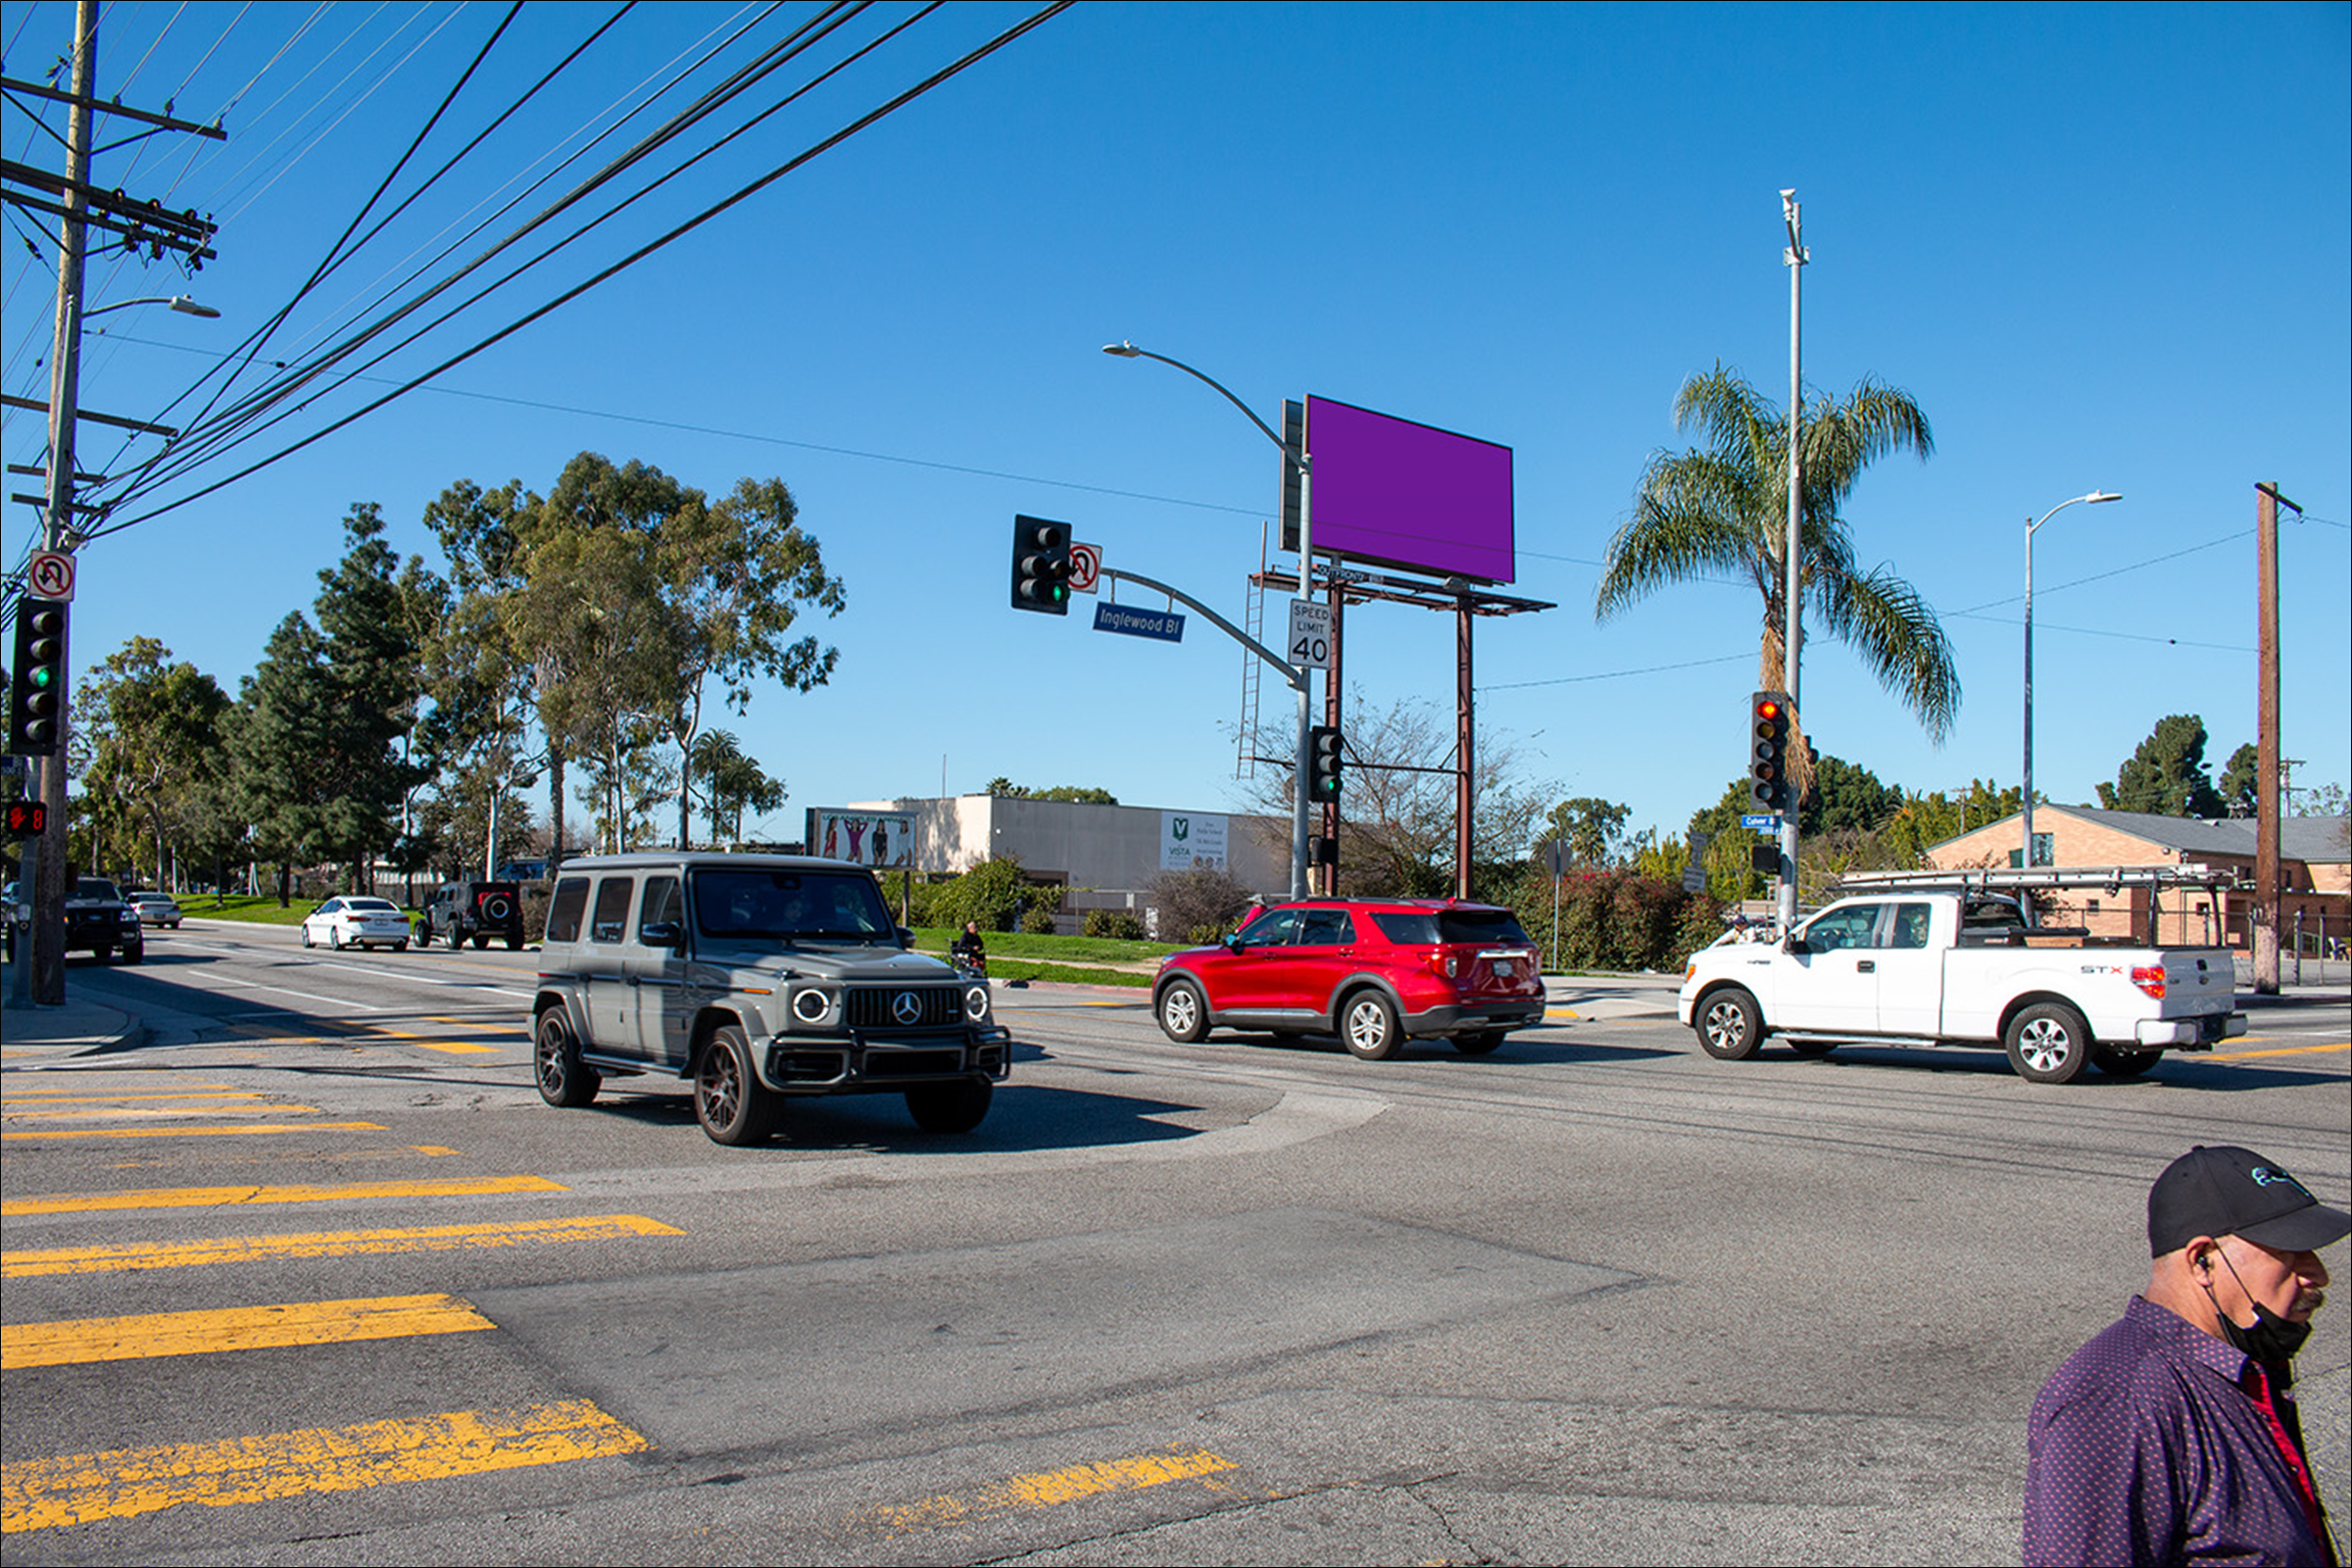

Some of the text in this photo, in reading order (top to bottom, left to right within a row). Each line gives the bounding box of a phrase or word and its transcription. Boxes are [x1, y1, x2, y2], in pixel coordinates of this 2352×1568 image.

[1294, 605, 1329, 620] SPEED
[1100, 609, 1179, 634] Inglewood Bl
[1297, 621, 1324, 634] LIMIT
[1293, 637, 1327, 662] 40
[1168, 847, 1190, 856] VISTA
[2081, 965, 2123, 974] STX
